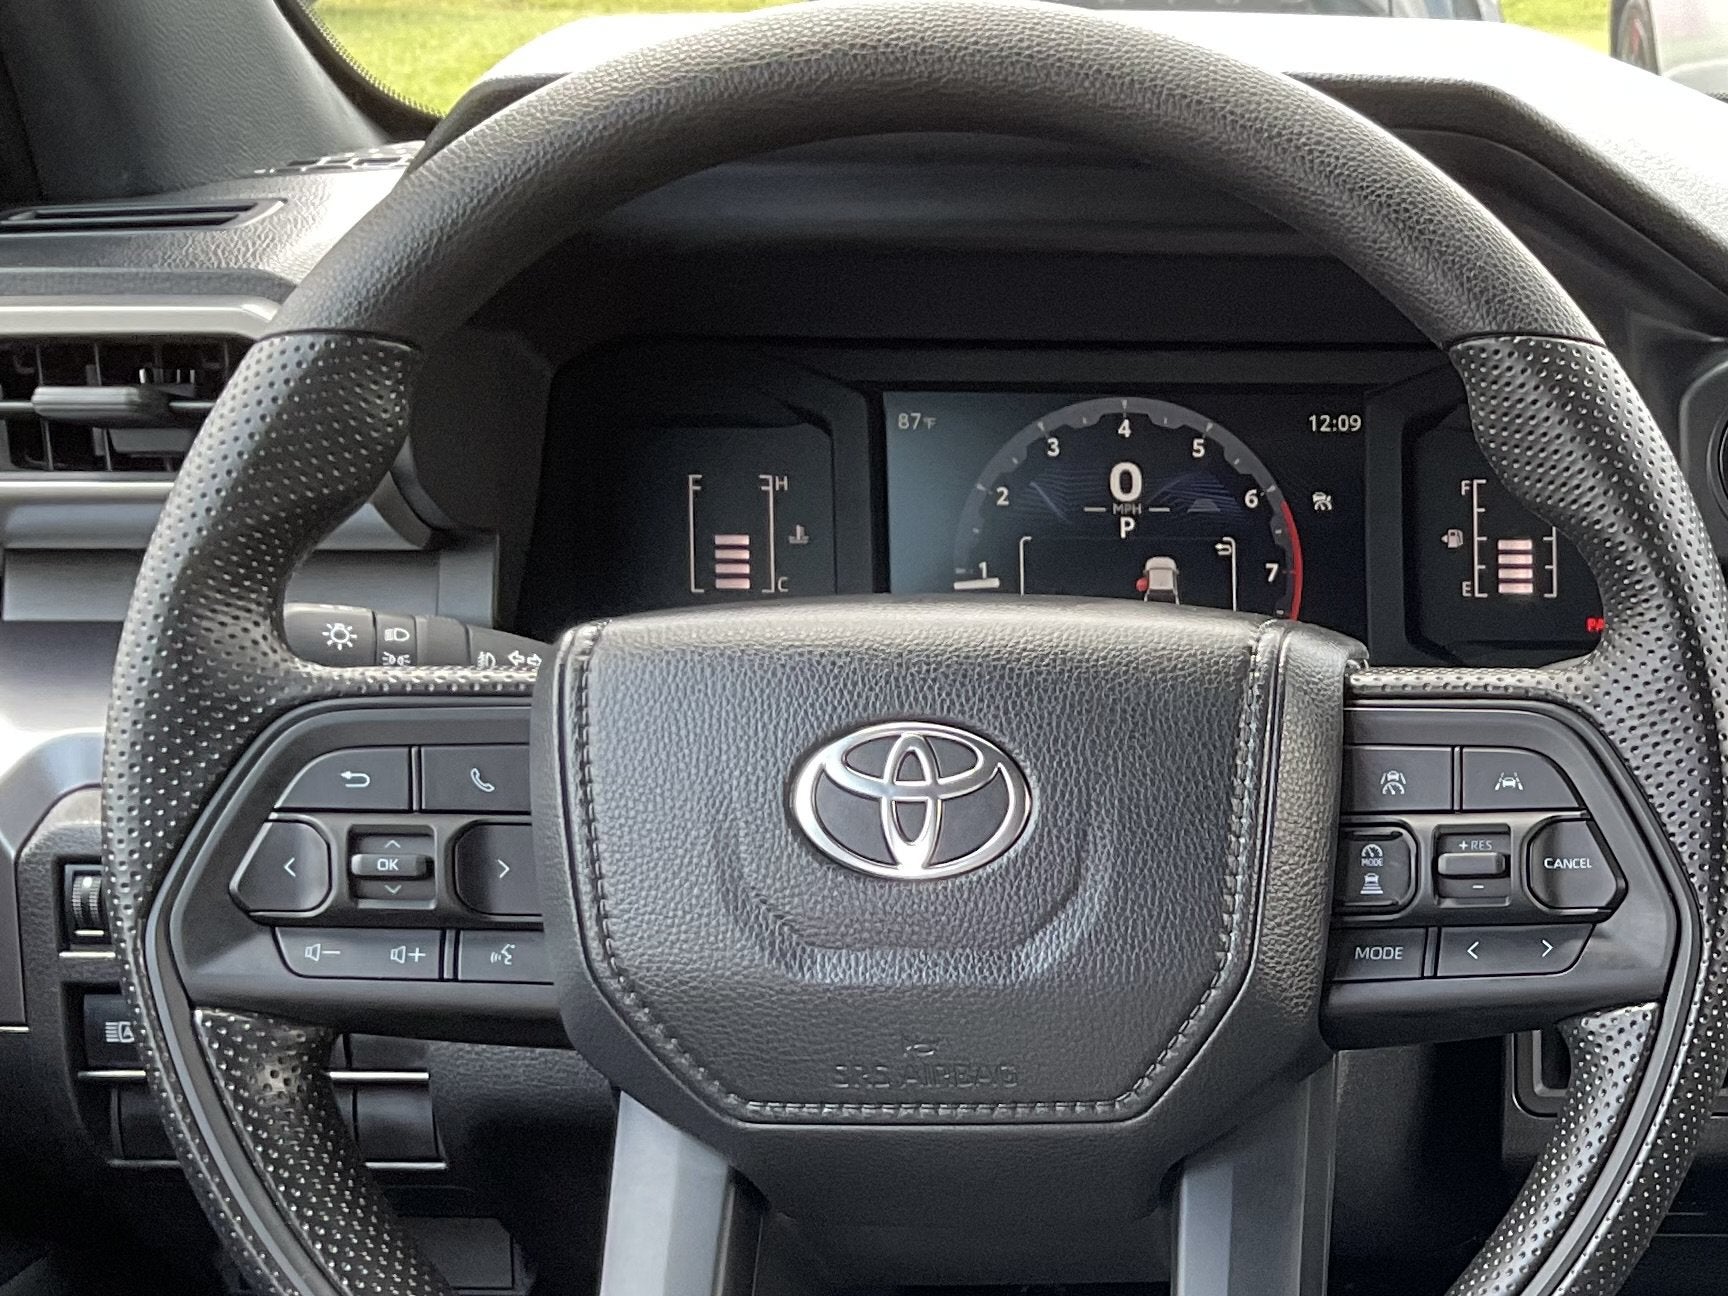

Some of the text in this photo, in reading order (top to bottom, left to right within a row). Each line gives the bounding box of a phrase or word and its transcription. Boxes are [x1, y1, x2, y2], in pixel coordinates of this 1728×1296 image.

[1117, 419, 1131, 438] 4
[1308, 414, 1362, 432] 12:09
[1047, 438, 1060, 457] 3
[1192, 438, 1205, 458] 5
[775, 475, 788, 491] H
[1109, 462, 1143, 502] 0
[1461, 480, 1471, 496] F
[996, 487, 1010, 506] 2
[1244, 489, 1259, 508] 6
[1112, 504, 1142, 515] MPH
[1120, 517, 1135, 539] P
[979, 561, 988, 579] 1
[1265, 563, 1279, 582] 7
[777, 577, 789, 592] C
[1462, 581, 1472, 597] E
[377, 859, 400, 871] OK
[1361, 858, 1384, 867] MODE
[1543, 858, 1592, 869] CANCEL
[1354, 946, 1404, 960] MODE
